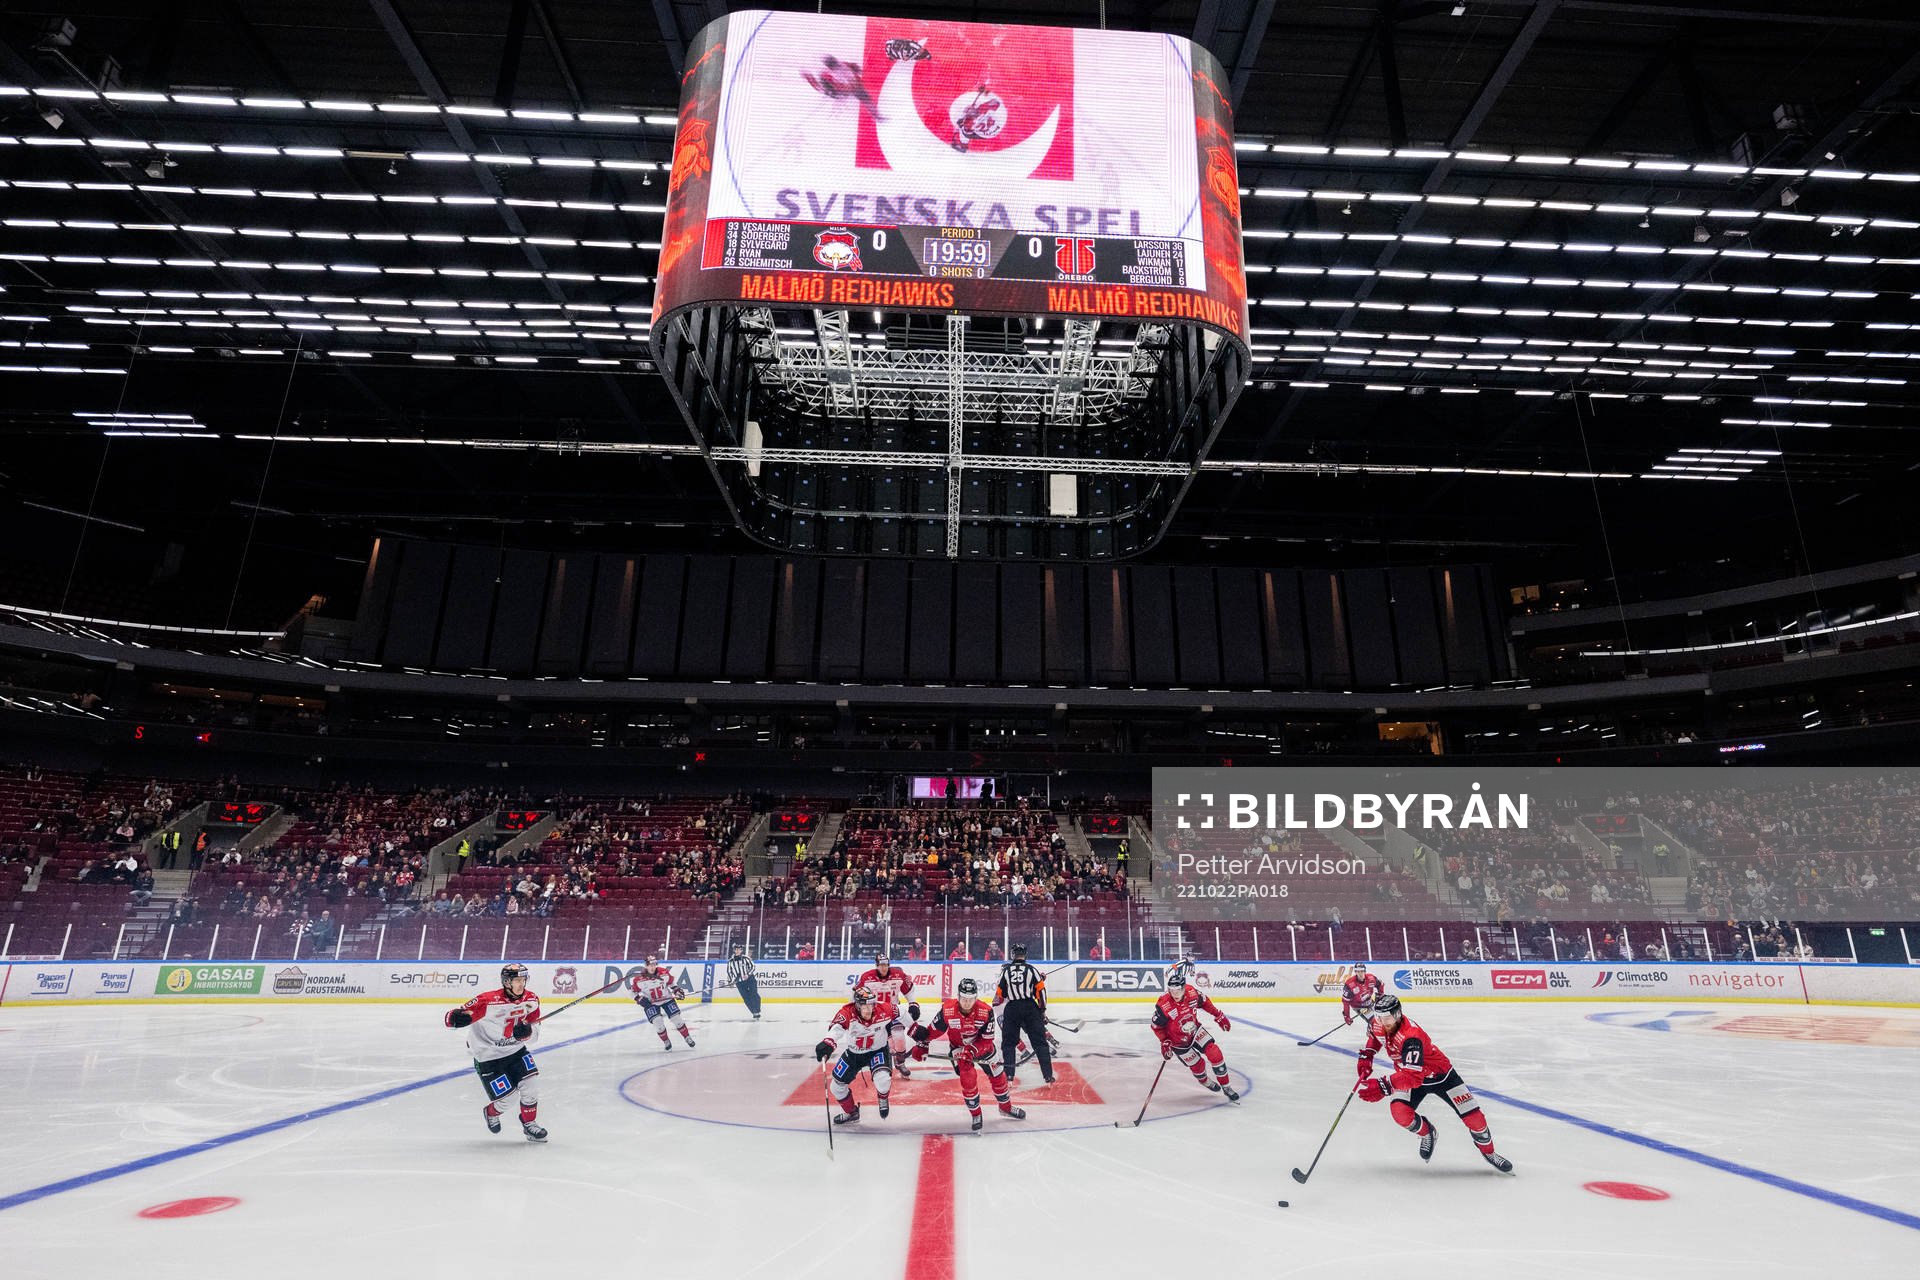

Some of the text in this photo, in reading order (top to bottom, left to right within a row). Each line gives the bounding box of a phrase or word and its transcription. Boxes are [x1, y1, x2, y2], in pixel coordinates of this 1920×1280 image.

[775, 188, 1014, 229] SVENSKA
[728, 222, 790, 232] 93 VESALAINEN
[727, 230, 790, 241] 34 SÖDERBERG
[941, 228, 981, 239] PERIOD 1
[728, 240, 737, 248] 18
[872, 230, 887, 251] 0
[1134, 240, 1183, 250] LARSSON 36
[930, 241, 987, 264] 19:59
[1028, 237, 1042, 258] 0
[726, 248, 761, 258] 47 RYAN
[1137, 249, 1183, 259] LAJUNEN 24
[724, 257, 793, 268] 26 SCHEMITSCH
[1137, 257, 1183, 268] WIKMAN 17
[929, 266, 984, 279] 0 SHOTS 0
[1058, 273, 1094, 281] ÖREBRO
[1179, 268, 1184, 276] 5
[1130, 275, 1185, 286] BERGLUND 6
[741, 274, 955, 307] MALMÖ REDHAWKS
[1048, 286, 1238, 334] MALMÖ REDHAWKS
[196, 968, 255, 980] GASAB
[1011, 971, 1024, 982] 25
[1413, 968, 1460, 977] HÖGTRYCKS
[1550, 972, 1566, 980] ALL
[1616, 971, 1668, 981] Climat80
[104, 980, 126, 988] Bygg
[307, 974, 346, 984] NORDANÅ
[390, 972, 479, 986] sandberg
[1213, 980, 1246, 988] HÄLSOSAM
[1414, 977, 1443, 985] TJÄNST
[1495, 975, 1543, 985] CCM
[1550, 980, 1571, 988] OUT.
[1689, 971, 1785, 990] navigator
[40, 981, 64, 989] Bygg
[305, 986, 366, 994] GRUSTERMINAL
[1406, 1051, 1420, 1063] 47
